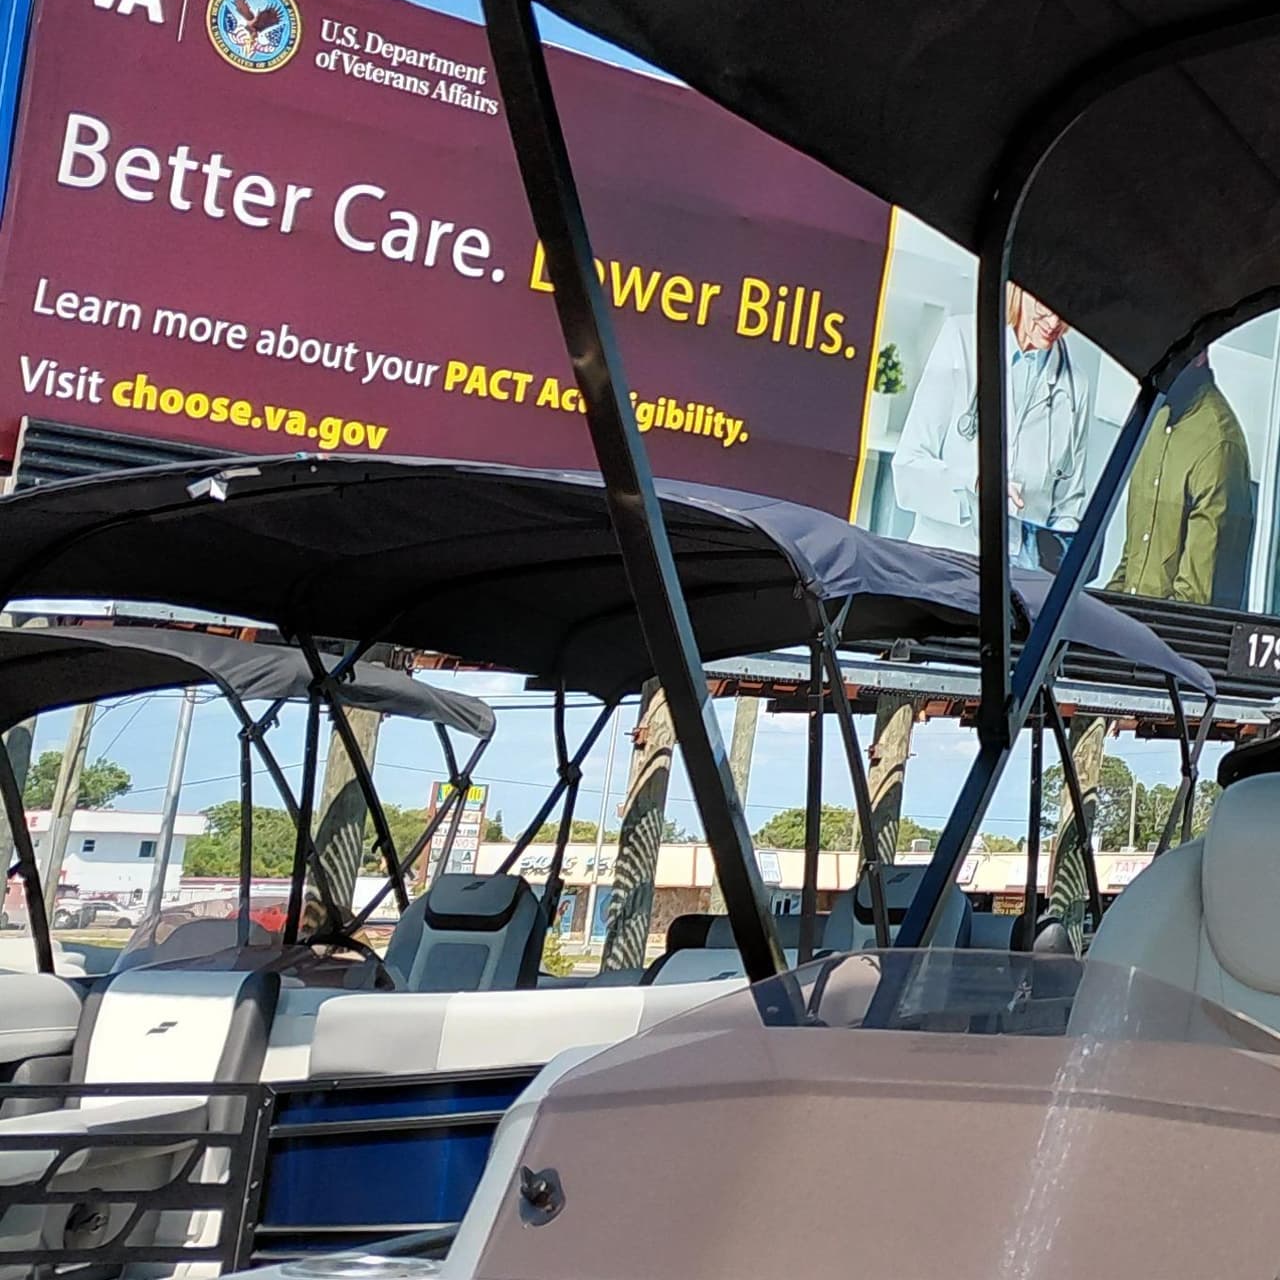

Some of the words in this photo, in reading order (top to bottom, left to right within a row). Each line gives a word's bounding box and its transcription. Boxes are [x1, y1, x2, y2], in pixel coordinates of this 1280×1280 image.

[315, 48, 342, 71] of
[341, 52, 431, 97] Veterans
[431, 79, 500, 116] Affairs
[320, 19, 361, 50] U.S.
[364, 31, 488, 86] Department
[57, 112, 313, 234] Better
[333, 184, 506, 284] Care.
[33, 278, 142, 330] Learn
[152, 308, 249, 350] more
[255, 324, 359, 372] about
[361, 350, 441, 388] your
[444, 360, 534, 403] PACT
[530, 239, 721, 326] Lwer
[736, 277, 857, 360] Bills.
[20, 355, 105, 403] Visit
[111, 373, 389, 450] choose.va.gov
